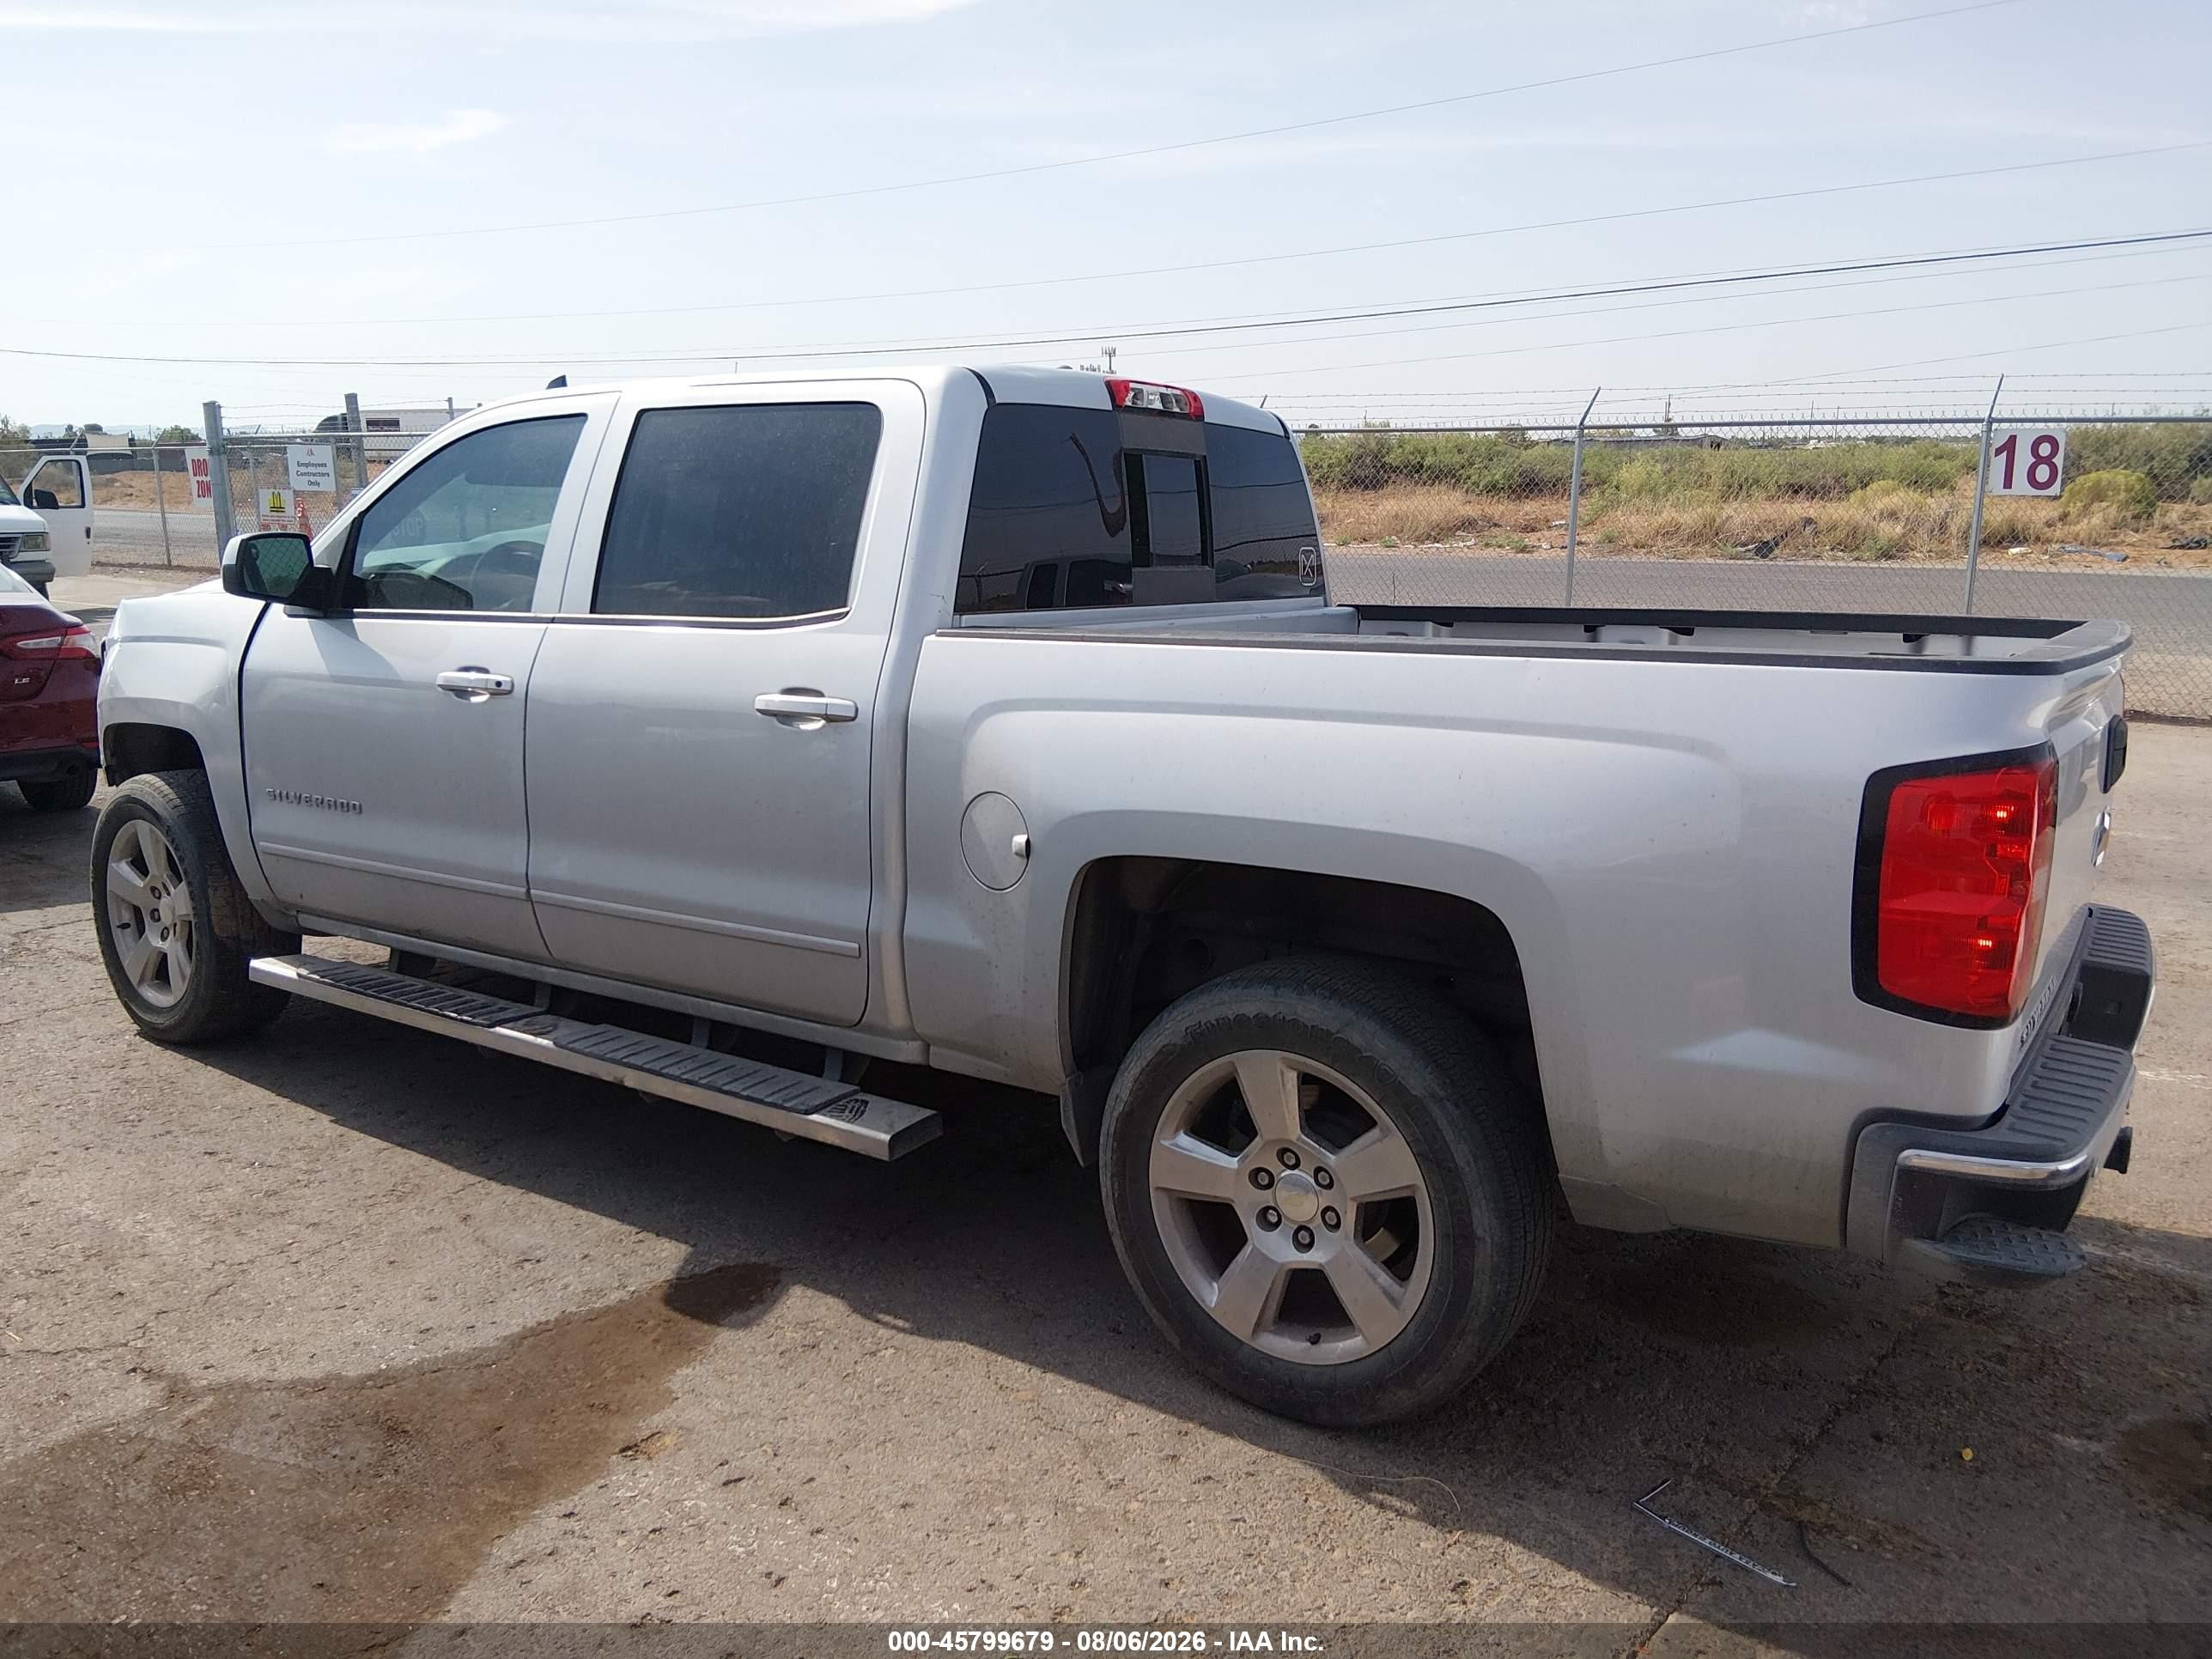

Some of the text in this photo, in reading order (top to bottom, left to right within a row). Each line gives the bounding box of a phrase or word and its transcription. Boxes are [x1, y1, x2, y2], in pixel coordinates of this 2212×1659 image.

[191, 459, 210, 477] DRO
[296, 460, 327, 469] Employees
[1994, 434, 2059, 490] 18
[196, 480, 213, 499] ZON
[265, 788, 362, 814] SILVERADO
